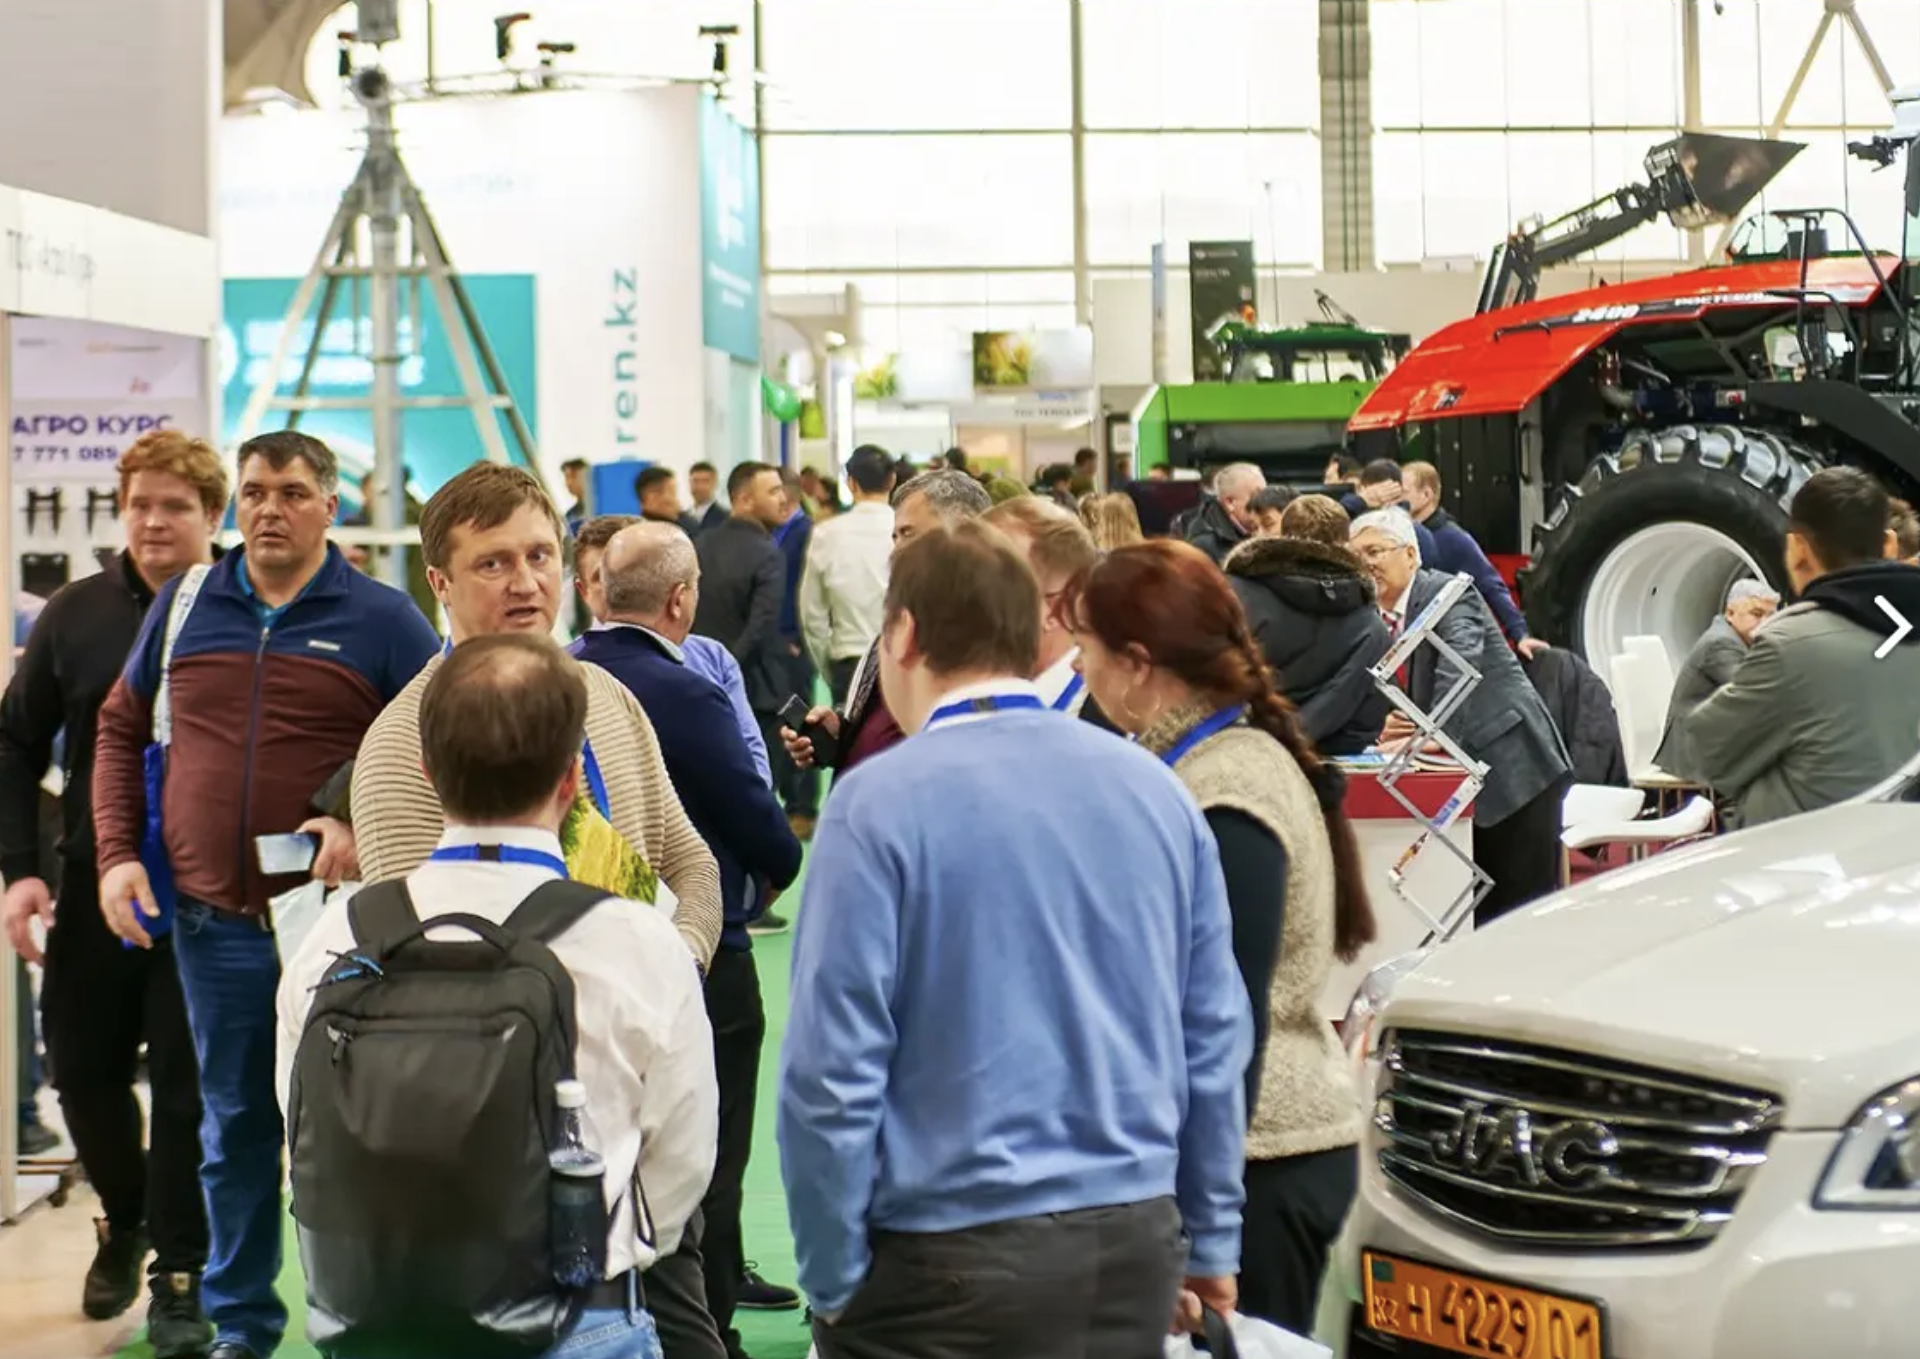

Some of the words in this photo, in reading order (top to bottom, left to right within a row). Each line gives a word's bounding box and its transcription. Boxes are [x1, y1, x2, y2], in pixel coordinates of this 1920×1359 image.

[604, 267, 638, 460] ren.kz
[13, 415, 88, 435] АГРО
[97, 414, 173, 435] КУРС
[1430, 1099, 1619, 1192] JAC
[1374, 1295, 1400, 1327] KZ
[1441, 1281, 1537, 1359] 4229
